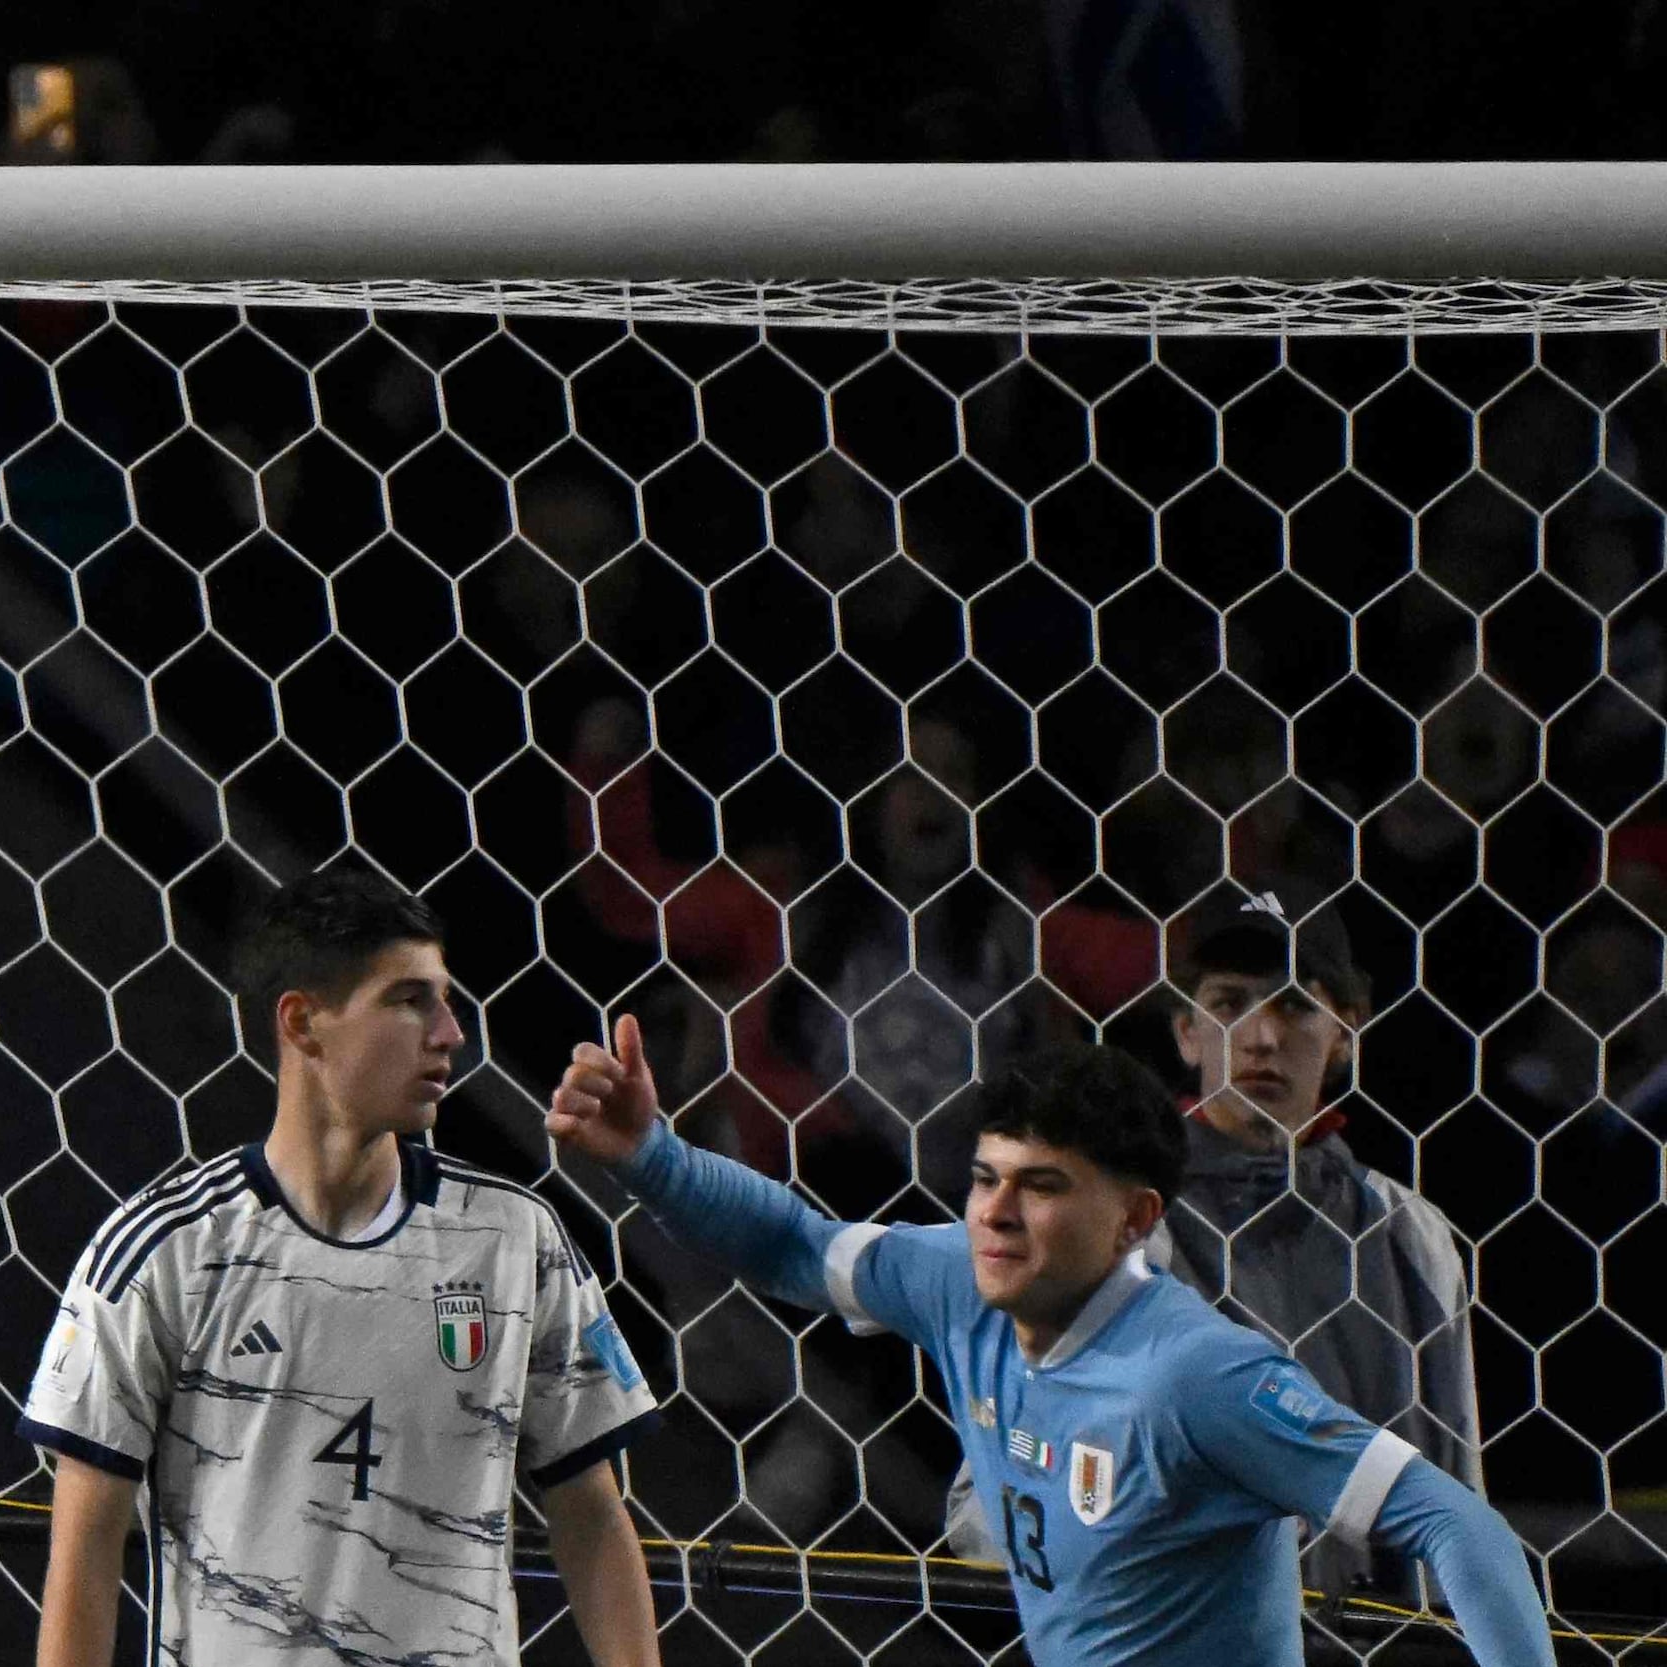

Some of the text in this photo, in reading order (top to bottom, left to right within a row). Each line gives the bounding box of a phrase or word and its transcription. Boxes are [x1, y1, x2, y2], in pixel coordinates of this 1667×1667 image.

[438, 1300, 481, 1316] ITALIA
[312, 1396, 382, 1502] 4
[1001, 1482, 1056, 1593] 13
